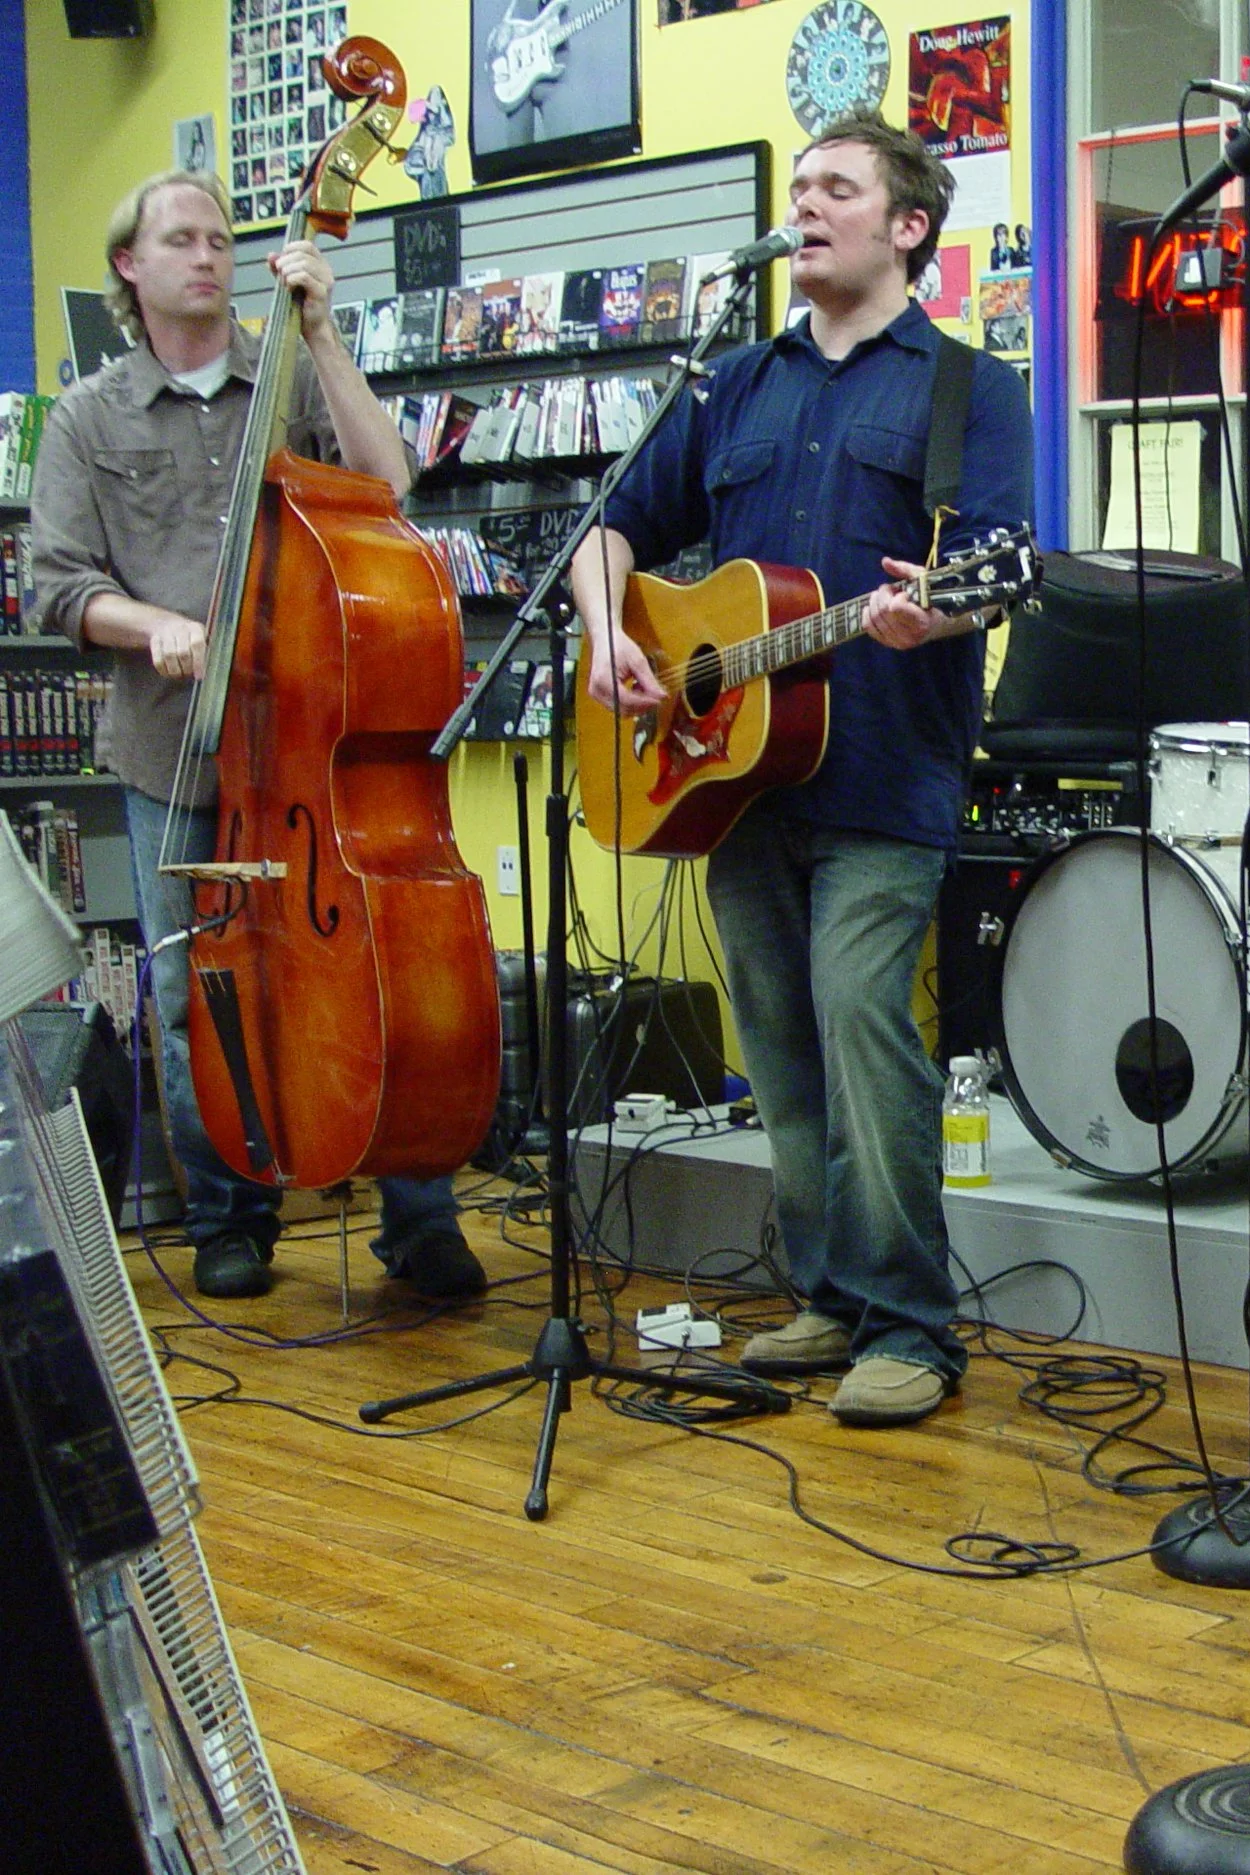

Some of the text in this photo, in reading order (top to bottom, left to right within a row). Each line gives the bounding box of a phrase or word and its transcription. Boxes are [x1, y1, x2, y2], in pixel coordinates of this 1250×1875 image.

[919, 24, 999, 53] Doug Hewitt
[924, 133, 1008, 156] casso Tomato
[1127, 439, 1157, 450] CAFT
